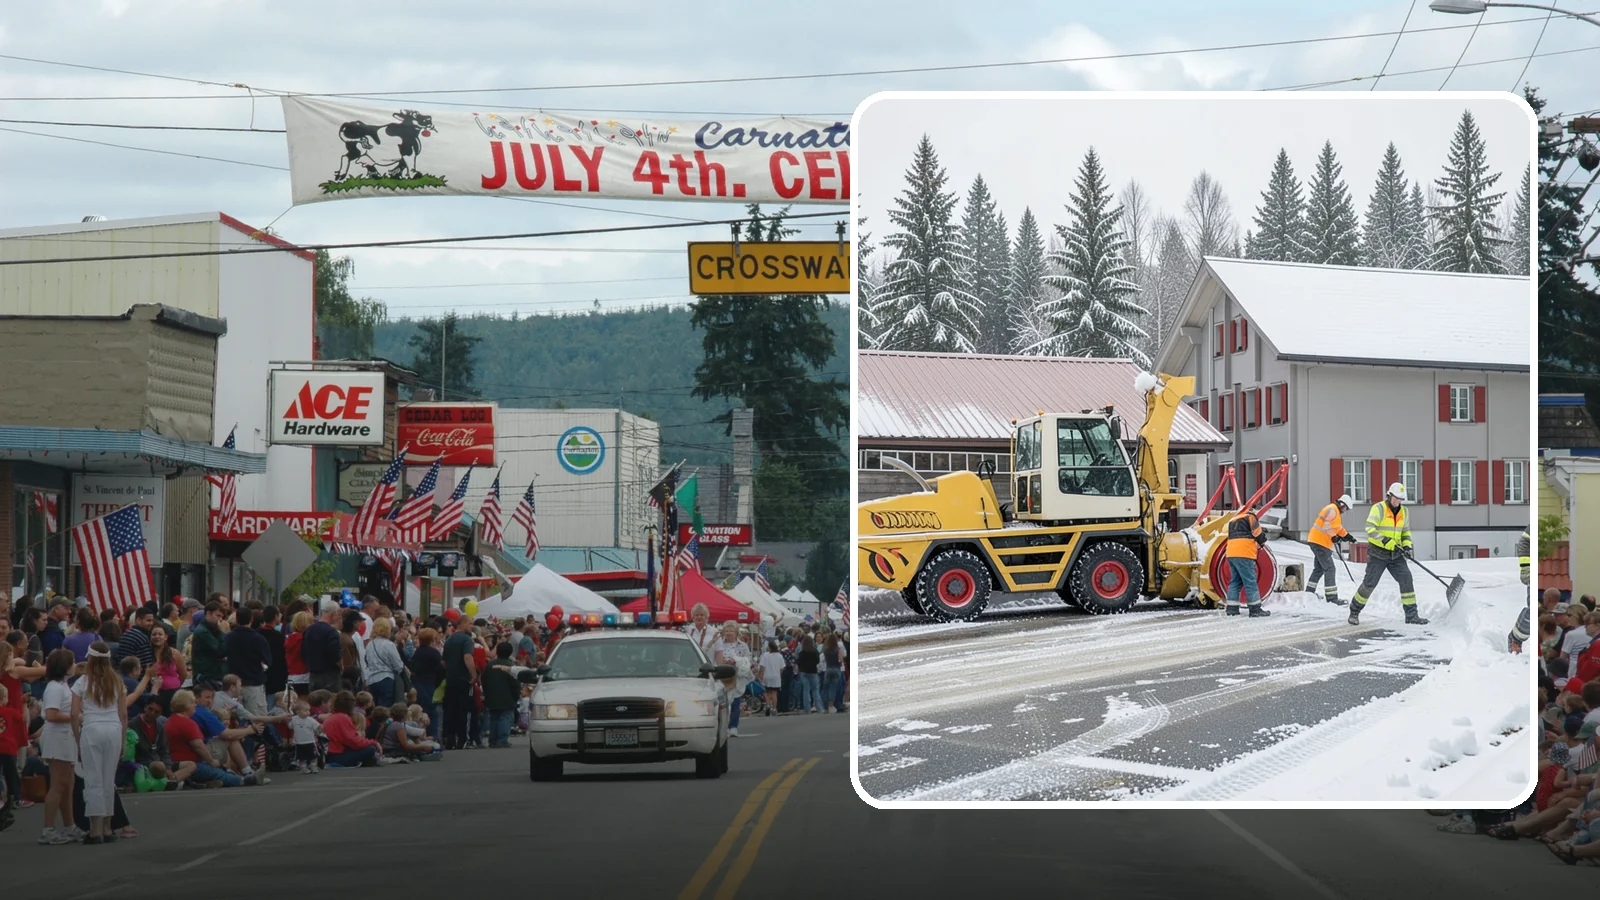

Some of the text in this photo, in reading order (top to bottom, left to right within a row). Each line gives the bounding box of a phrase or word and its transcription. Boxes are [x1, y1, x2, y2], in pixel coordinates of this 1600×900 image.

[481, 140, 605, 192] JULY
[632, 149, 746, 198] 4th.
[697, 254, 850, 280] CROSSWA
[283, 380, 373, 420] ACE
[405, 409, 485, 422] CEDAR LOG
[283, 421, 371, 436] Hardware
[416, 428, 476, 447] Coca-Cola
[83, 485, 155, 495] St. Vincent de Paul
[212, 516, 331, 535] HARDARE
[688, 526, 741, 535] CRNATION
[699, 535, 730, 543] GLASS
